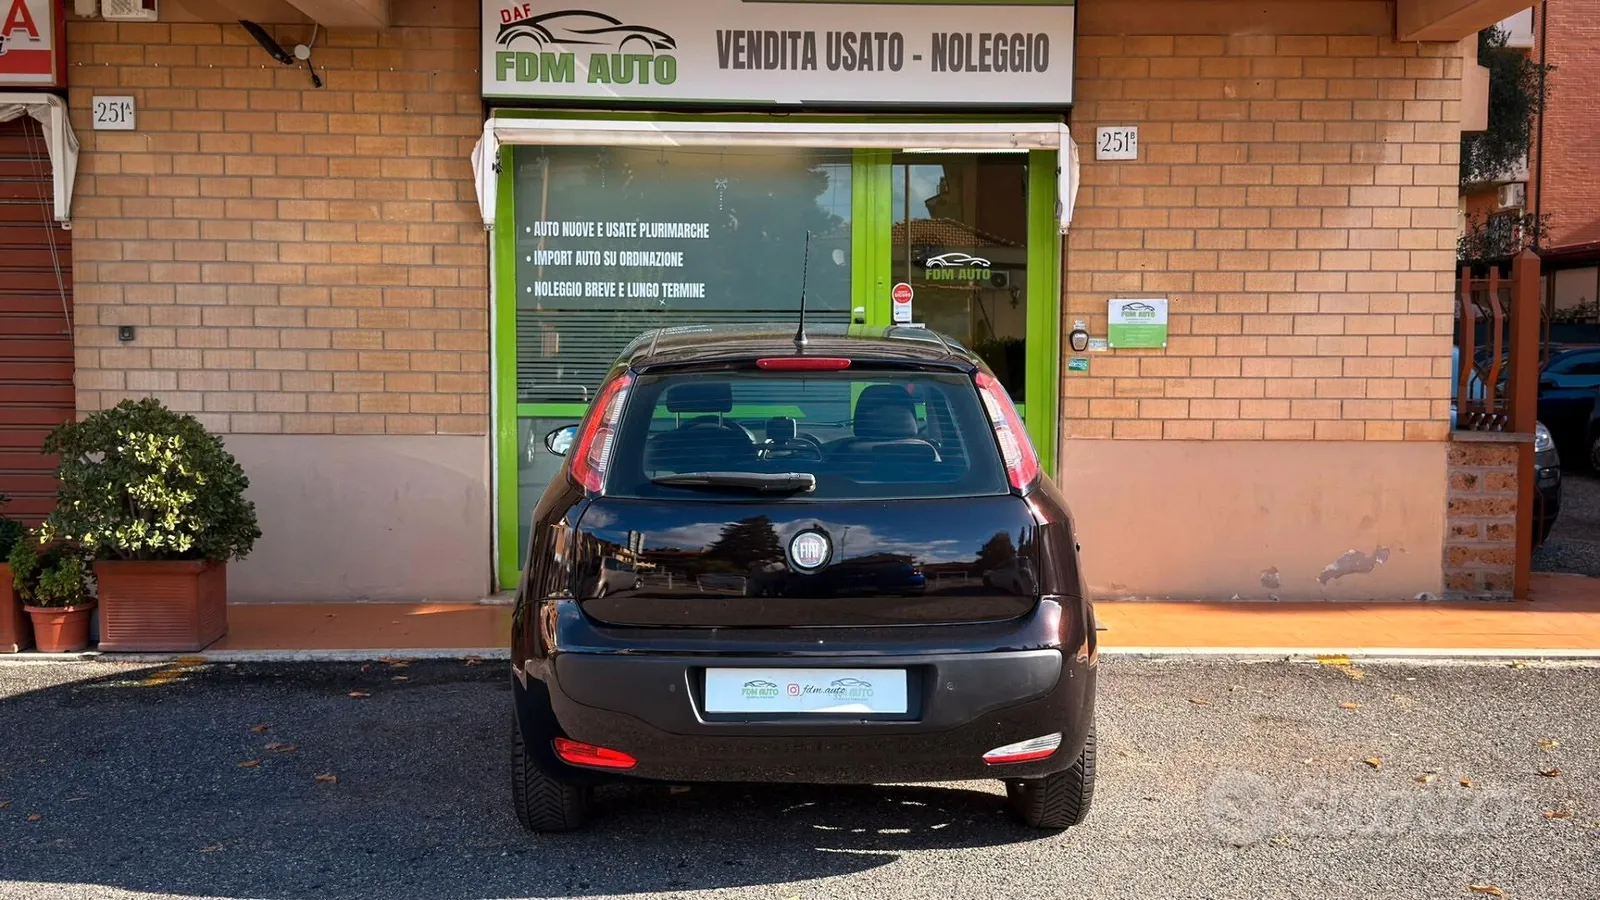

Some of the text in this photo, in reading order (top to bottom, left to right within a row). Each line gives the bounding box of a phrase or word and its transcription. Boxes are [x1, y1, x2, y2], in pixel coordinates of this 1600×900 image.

[500, 3, 532, 24] DAF
[716, 29, 818, 71] VENDITA
[826, 31, 904, 72] USATO
[931, 32, 1050, 73] NOLEGGIO
[495, 51, 677, 85] FDM AUTO
[533, 221, 710, 239] AUTO NUOVE E USATE PLURIMARCHE
[534, 250, 684, 267] IMPORT AUTO SU ORDINAZIONE
[925, 268, 991, 280] FDM AUTO
[534, 281, 705, 298] NOLEGGIO BREVE E LUNGO TERMINE
[800, 542, 820, 558] FIAT
[759, 688, 779, 696] AUTO
[799, 684, 846, 697] fdm.auto
[849, 688, 874, 697] AUTO
